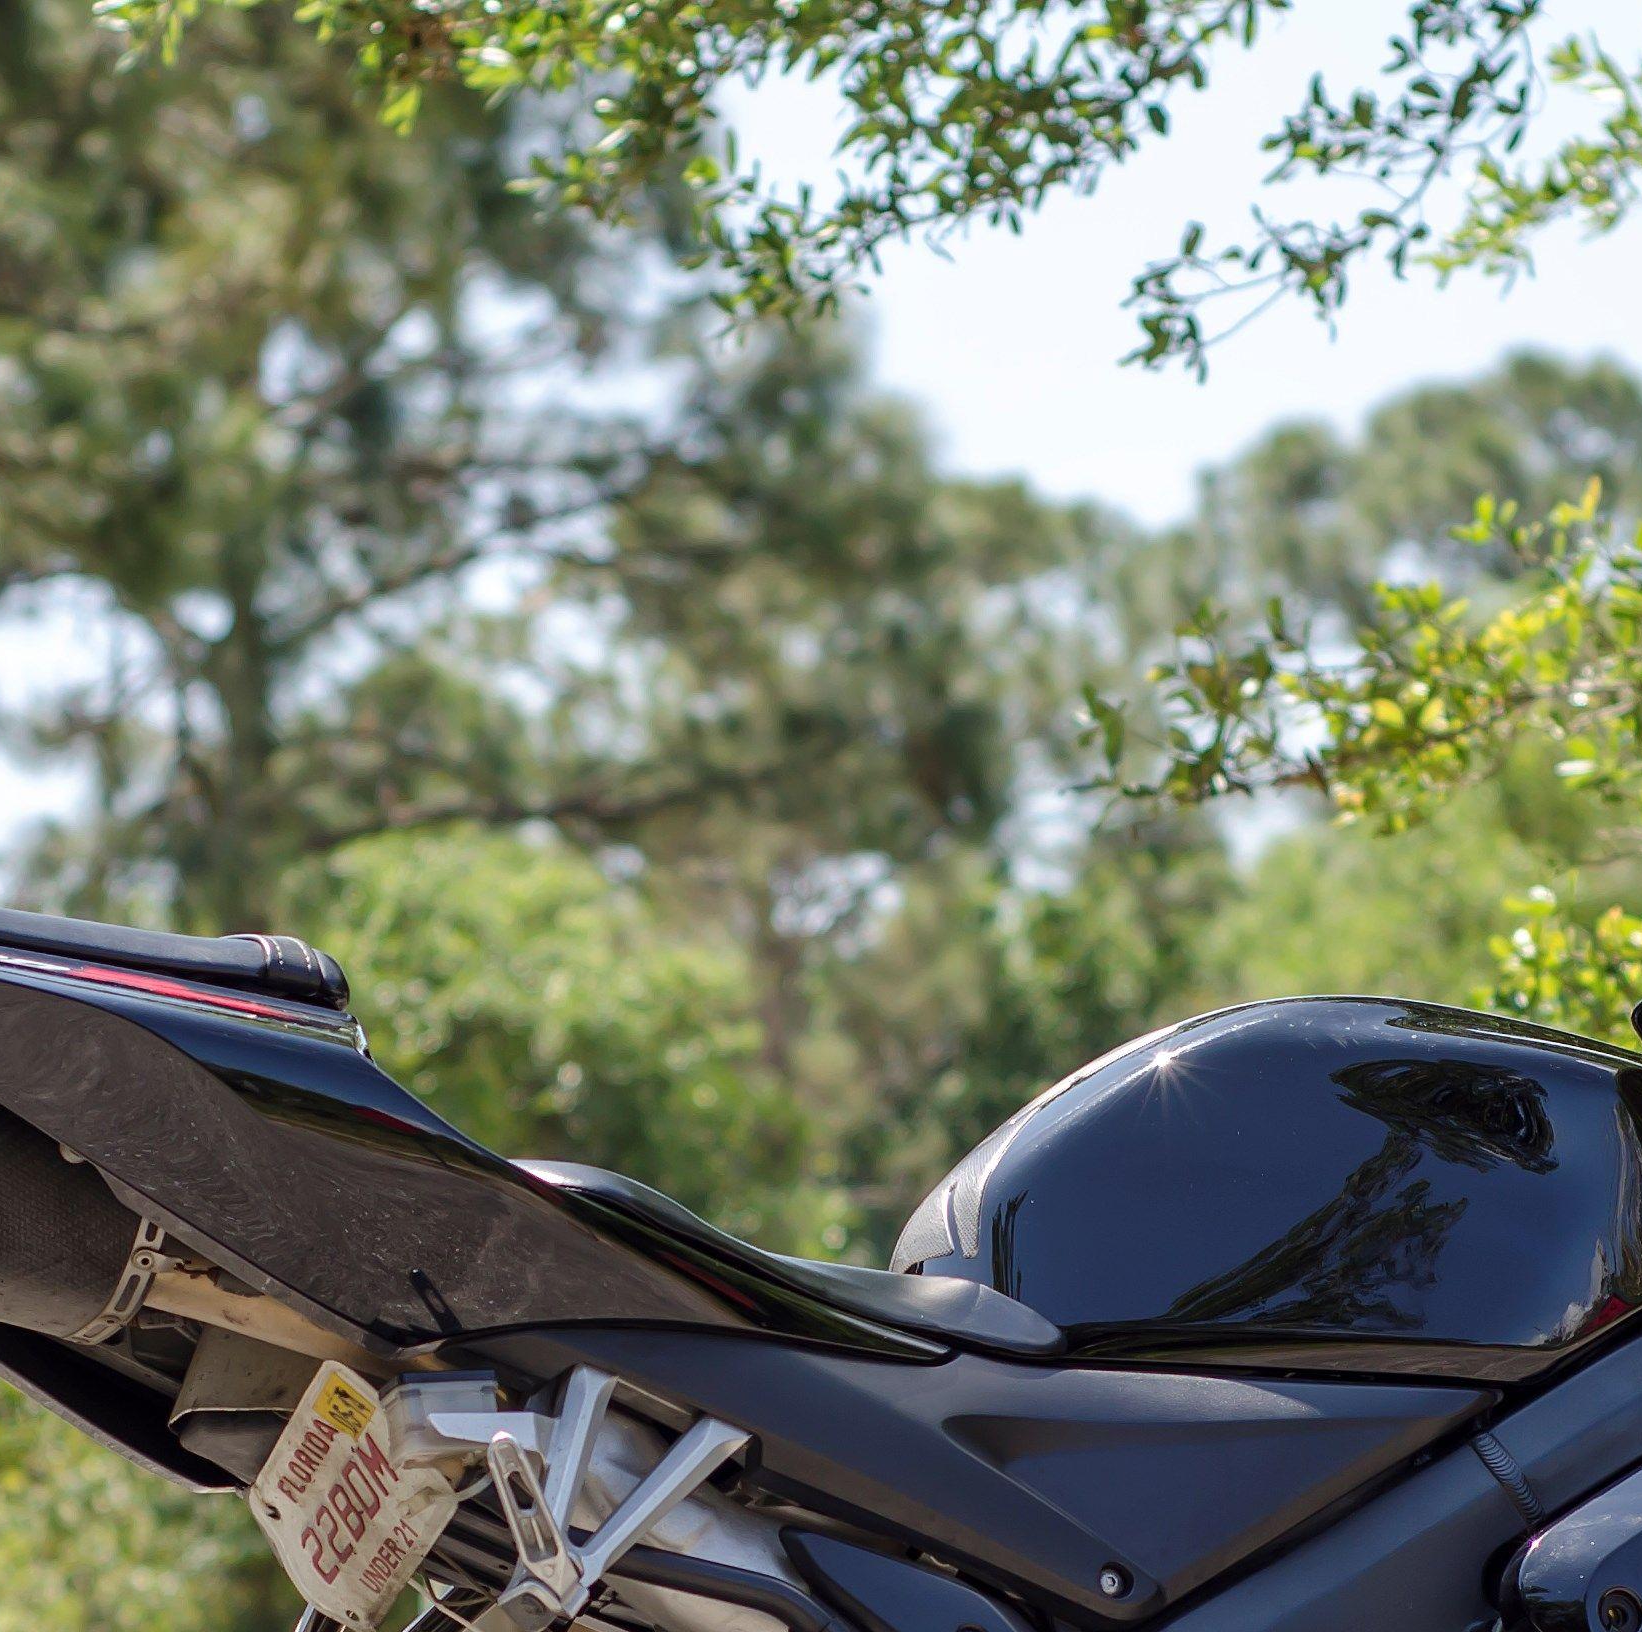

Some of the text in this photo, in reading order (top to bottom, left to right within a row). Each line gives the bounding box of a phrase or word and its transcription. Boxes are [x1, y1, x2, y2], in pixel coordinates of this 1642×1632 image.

[277, 1418, 339, 1504] FLORIDA
[359, 1518, 419, 1595] UNDER 21
